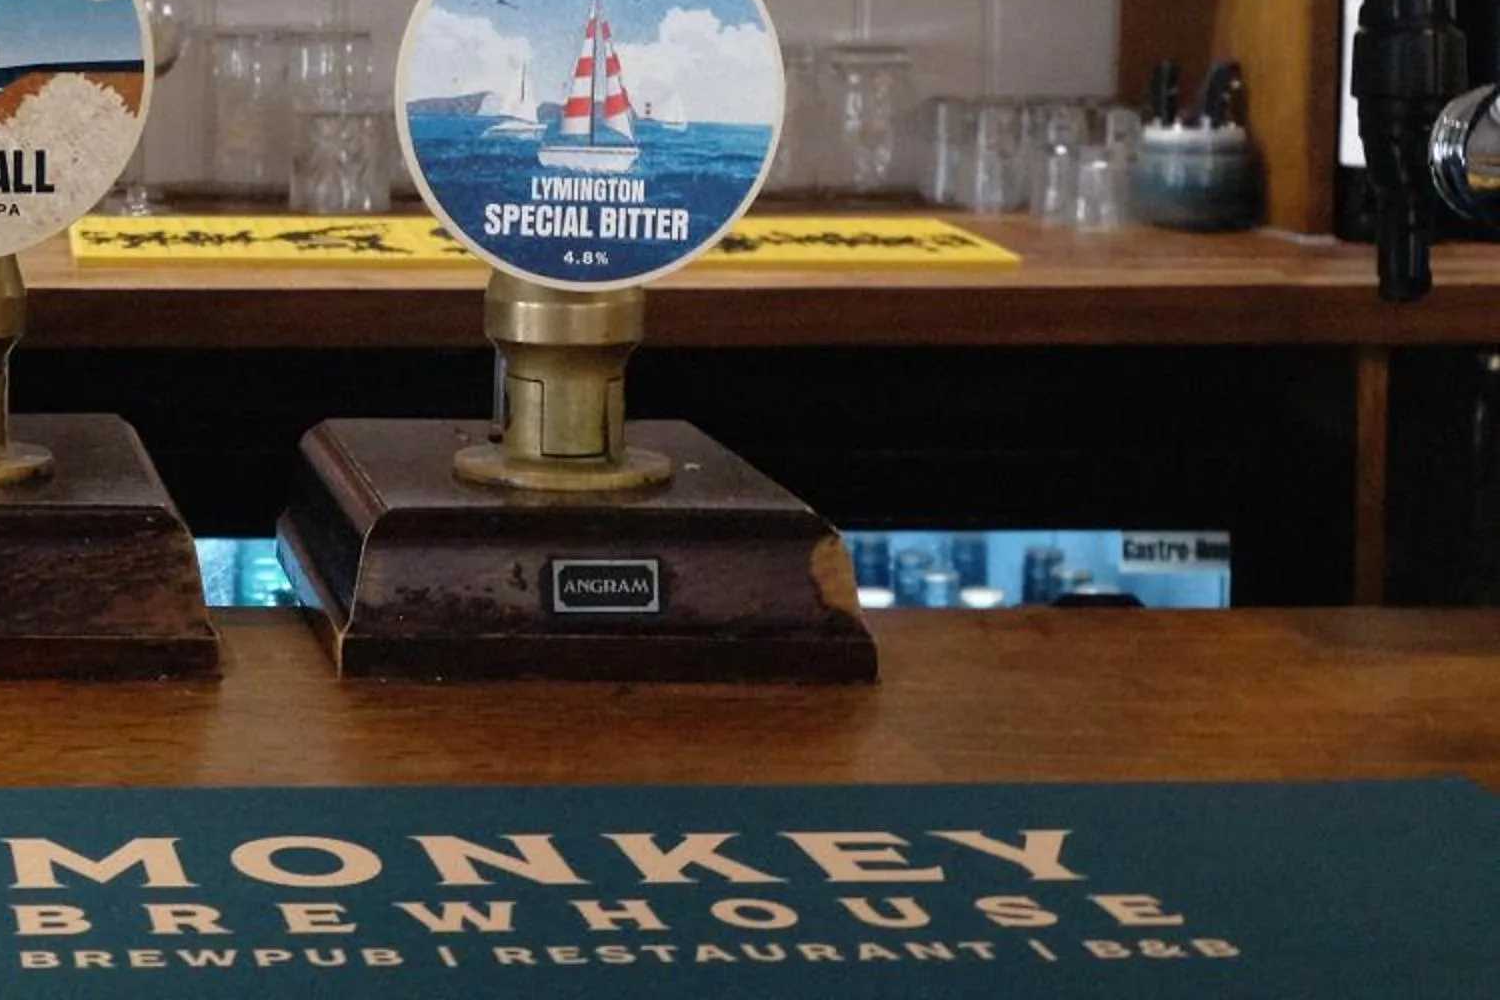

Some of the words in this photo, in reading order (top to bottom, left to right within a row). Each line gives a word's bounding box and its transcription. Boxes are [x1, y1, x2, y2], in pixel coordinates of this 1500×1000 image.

[531, 177, 645, 204] LYMINGTON
[484, 204, 593, 238] SPECIAL
[599, 206, 690, 241] BITTER
[563, 251, 609, 265] 4.8%
[563, 579, 650, 593] ANGRAM
[0, 829, 1090, 889] MONKEY
[9, 894, 1185, 936] BREWHOUSE
[19, 945, 404, 969] BREWPUB
[493, 940, 998, 966] RESTAURANT
[1083, 938, 1242, 959] B&B
